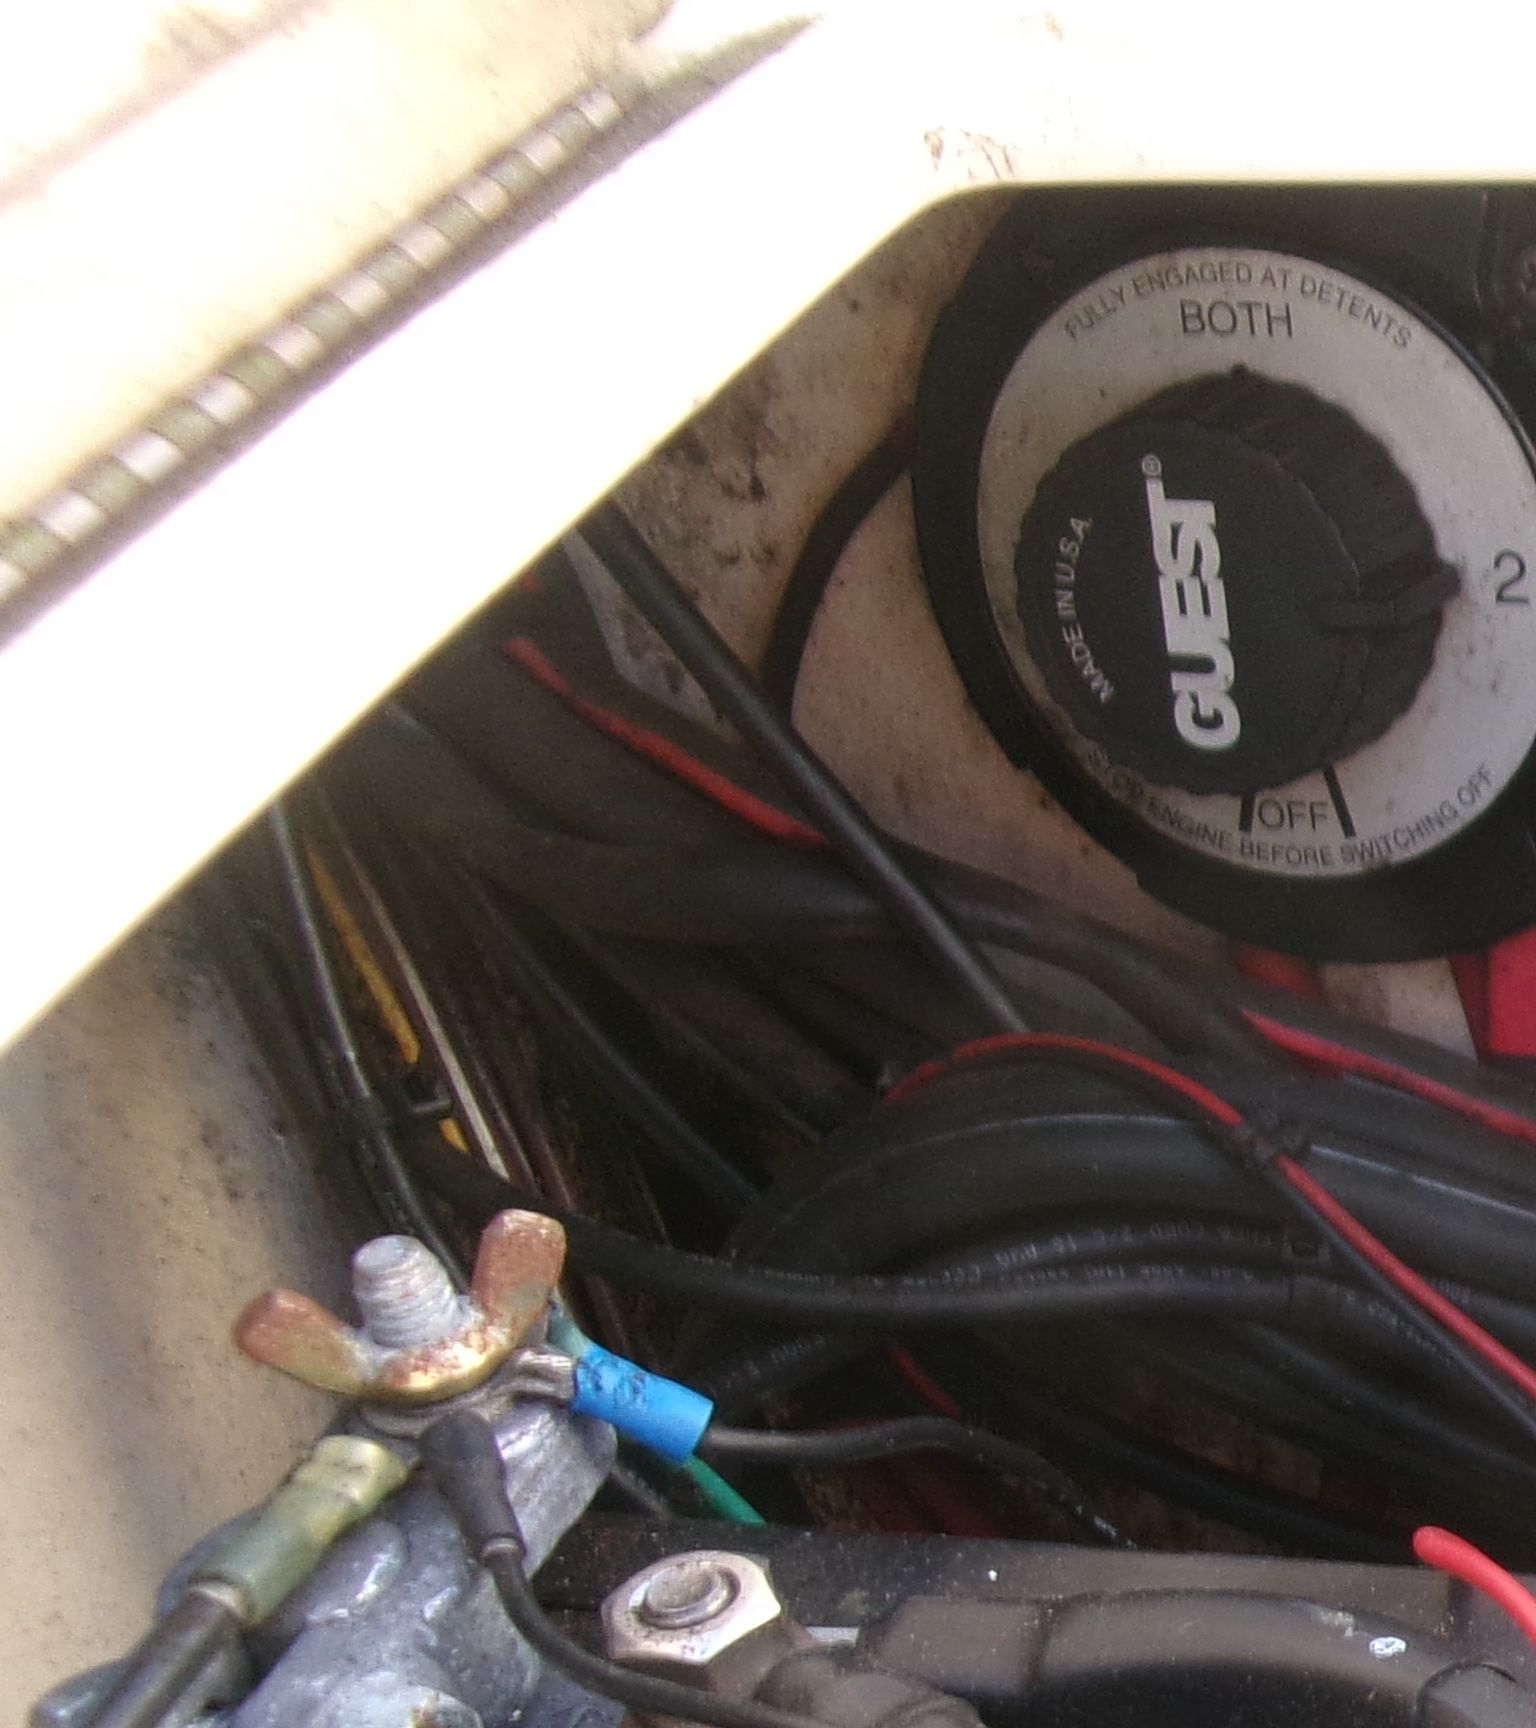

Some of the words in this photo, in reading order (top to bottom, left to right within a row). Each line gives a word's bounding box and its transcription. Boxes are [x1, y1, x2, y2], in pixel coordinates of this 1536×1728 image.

[1064, 284, 1128, 342] FULLY
[1131, 261, 1253, 297] ENGAGED
[1261, 263, 1292, 290] AT
[1300, 273, 1413, 349] DETENTS
[1180, 300, 1294, 338] BOTH
[1055, 589, 1077, 617] IN
[1494, 548, 1530, 604] 2
[1061, 623, 1115, 703] MADE
[1146, 796, 1234, 850] ENGINE
[1240, 836, 1332, 866] BEFORE
[1340, 801, 1459, 864] SWITCHING
[1456, 763, 1493, 807] OFF
[1257, 799, 1328, 832] OFF
